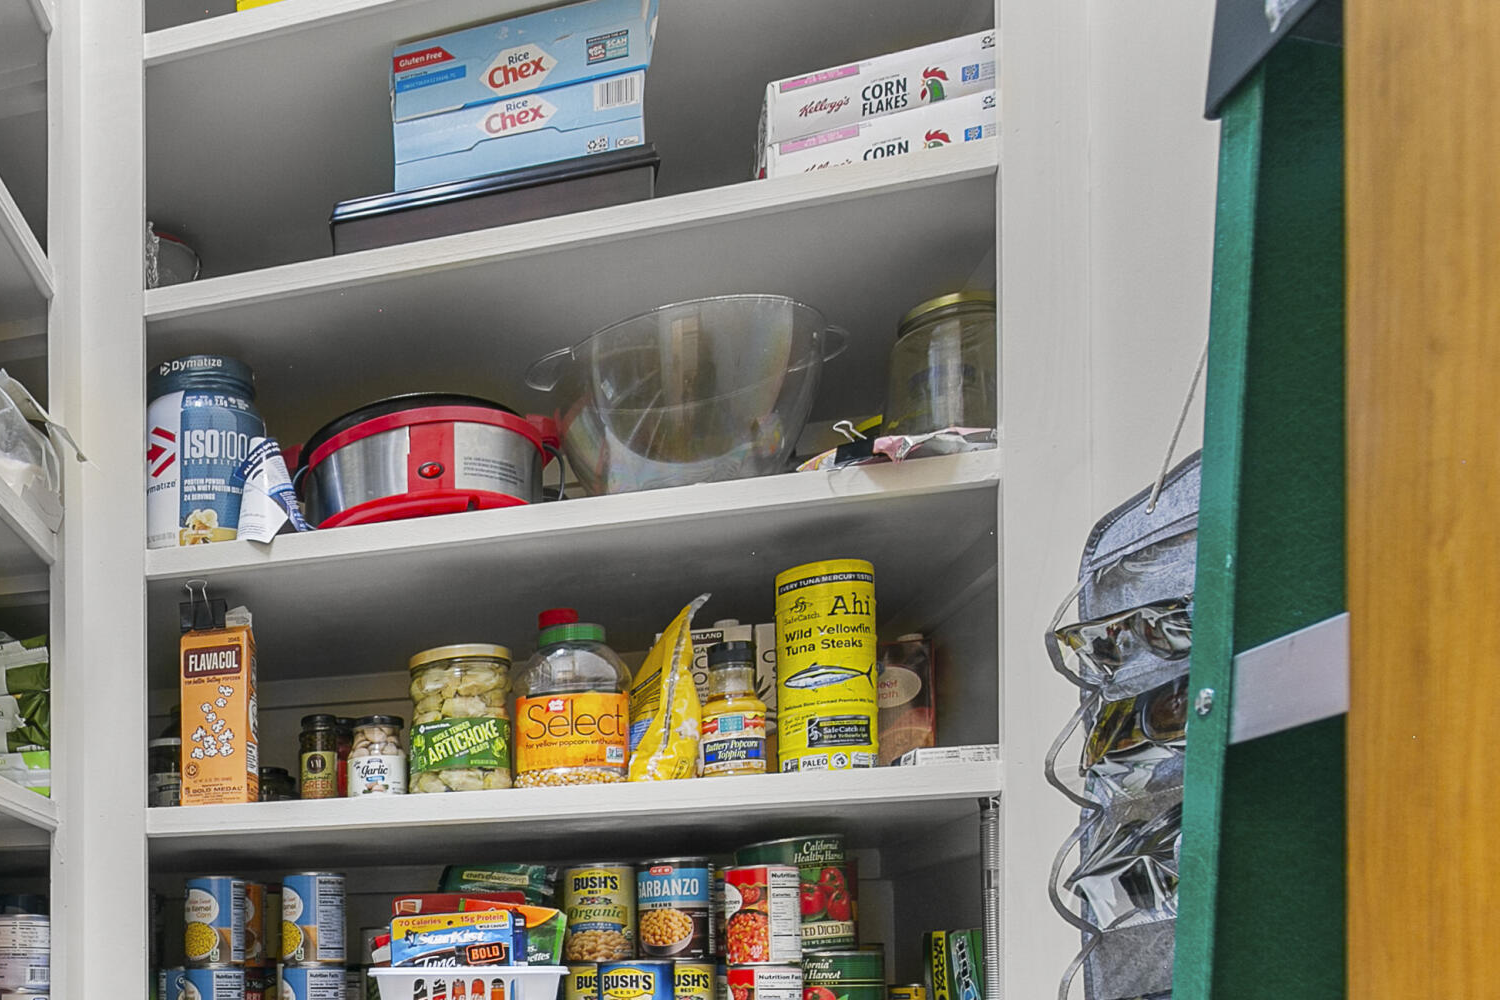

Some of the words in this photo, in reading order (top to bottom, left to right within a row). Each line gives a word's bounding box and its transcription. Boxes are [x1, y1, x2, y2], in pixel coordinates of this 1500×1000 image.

[399, 53, 423, 69] Gluten
[425, 49, 443, 64] Free
[508, 50, 530, 66] Rice
[487, 56, 546, 90] Chex
[861, 77, 908, 102] CORN
[506, 98, 528, 113] Rice
[799, 95, 850, 118] Kellogg's
[862, 93, 908, 117] FLAKES
[485, 104, 545, 135] Chex
[171, 358, 222, 372] Dymatize
[799, 577, 820, 587] TUNA
[827, 591, 871, 616] Ahi
[785, 627, 812, 643] Wild
[817, 623, 871, 636] Yellowfin
[785, 643, 816, 657] Tuna
[821, 637, 863, 650] Steaks
[188, 650, 238, 673] FLAVACOL
[526, 698, 624, 741] Select
[428, 719, 499, 765] ARTICHOKE
[802, 758, 828, 768] PALEO
[573, 875, 619, 892] BUSH'S
[476, 914, 504, 923] Protein
[569, 902, 625, 921] Organic
[417, 929, 484, 946] StarKist
[471, 945, 501, 960] BOLD
[603, 973, 652, 991] BUSH'S
